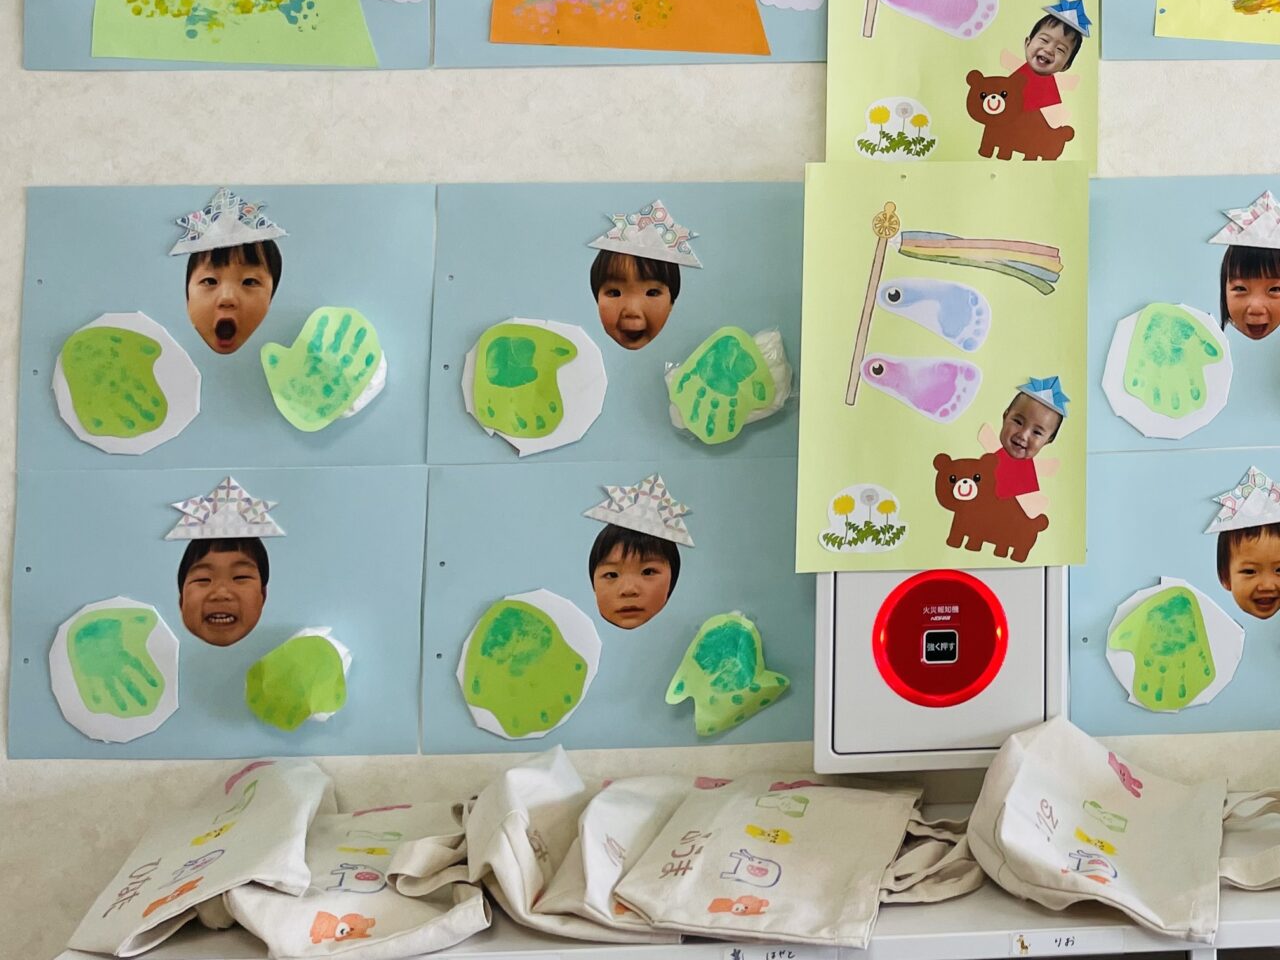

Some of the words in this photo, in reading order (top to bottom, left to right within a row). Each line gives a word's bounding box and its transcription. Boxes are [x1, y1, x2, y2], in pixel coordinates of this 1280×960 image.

[926, 642, 956, 652] 強く押す
[1054, 936, 1076, 948] りお
